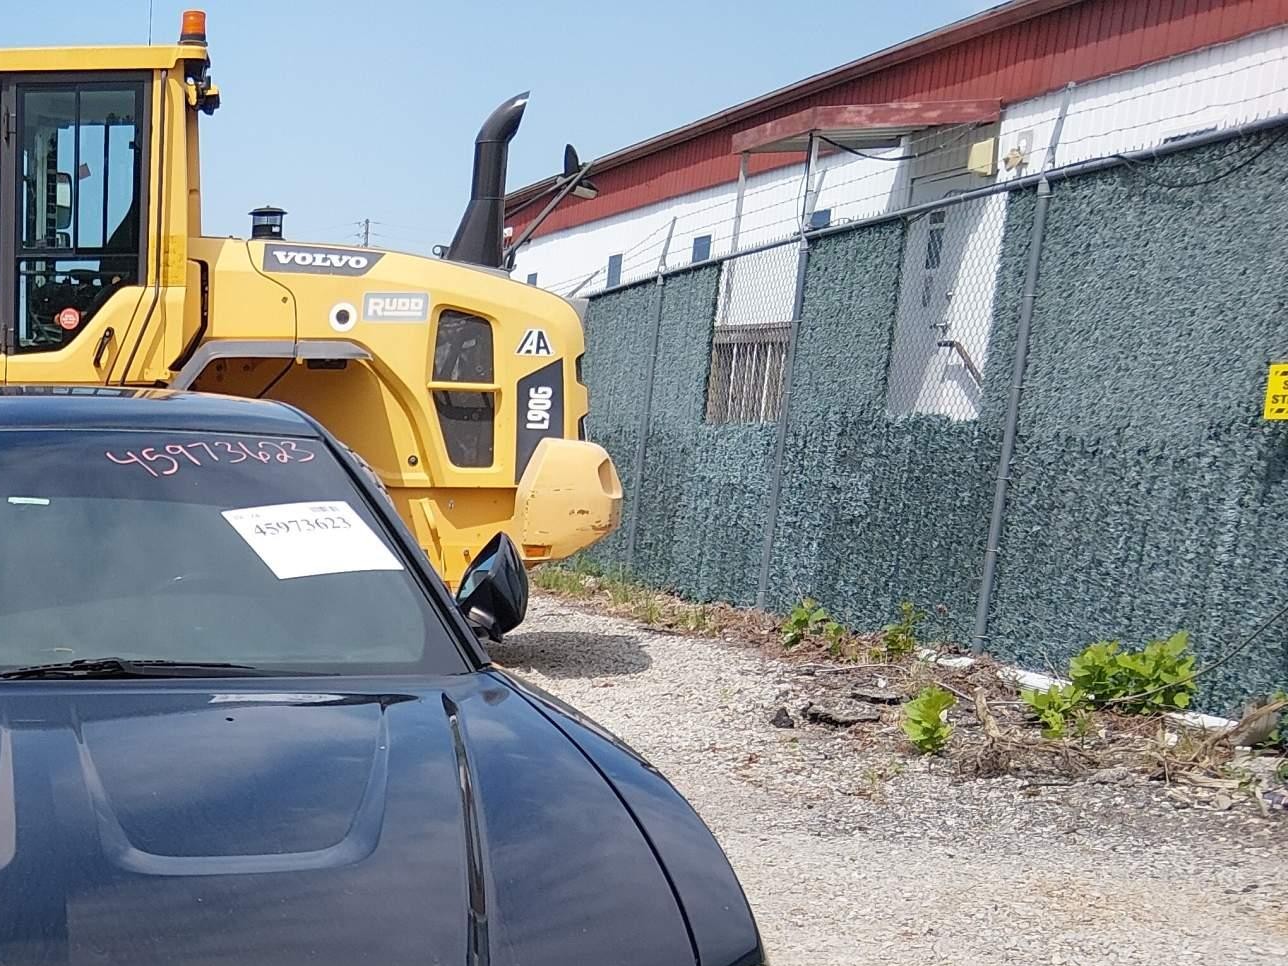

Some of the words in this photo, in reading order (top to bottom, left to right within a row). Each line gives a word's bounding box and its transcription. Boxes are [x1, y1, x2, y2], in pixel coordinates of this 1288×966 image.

[273, 251, 368, 269] VOLVO
[367, 297, 424, 317] RUDD
[525, 386, 553, 430] L90G
[106, 441, 315, 477] 45973623
[254, 515, 352, 536] 45973623
